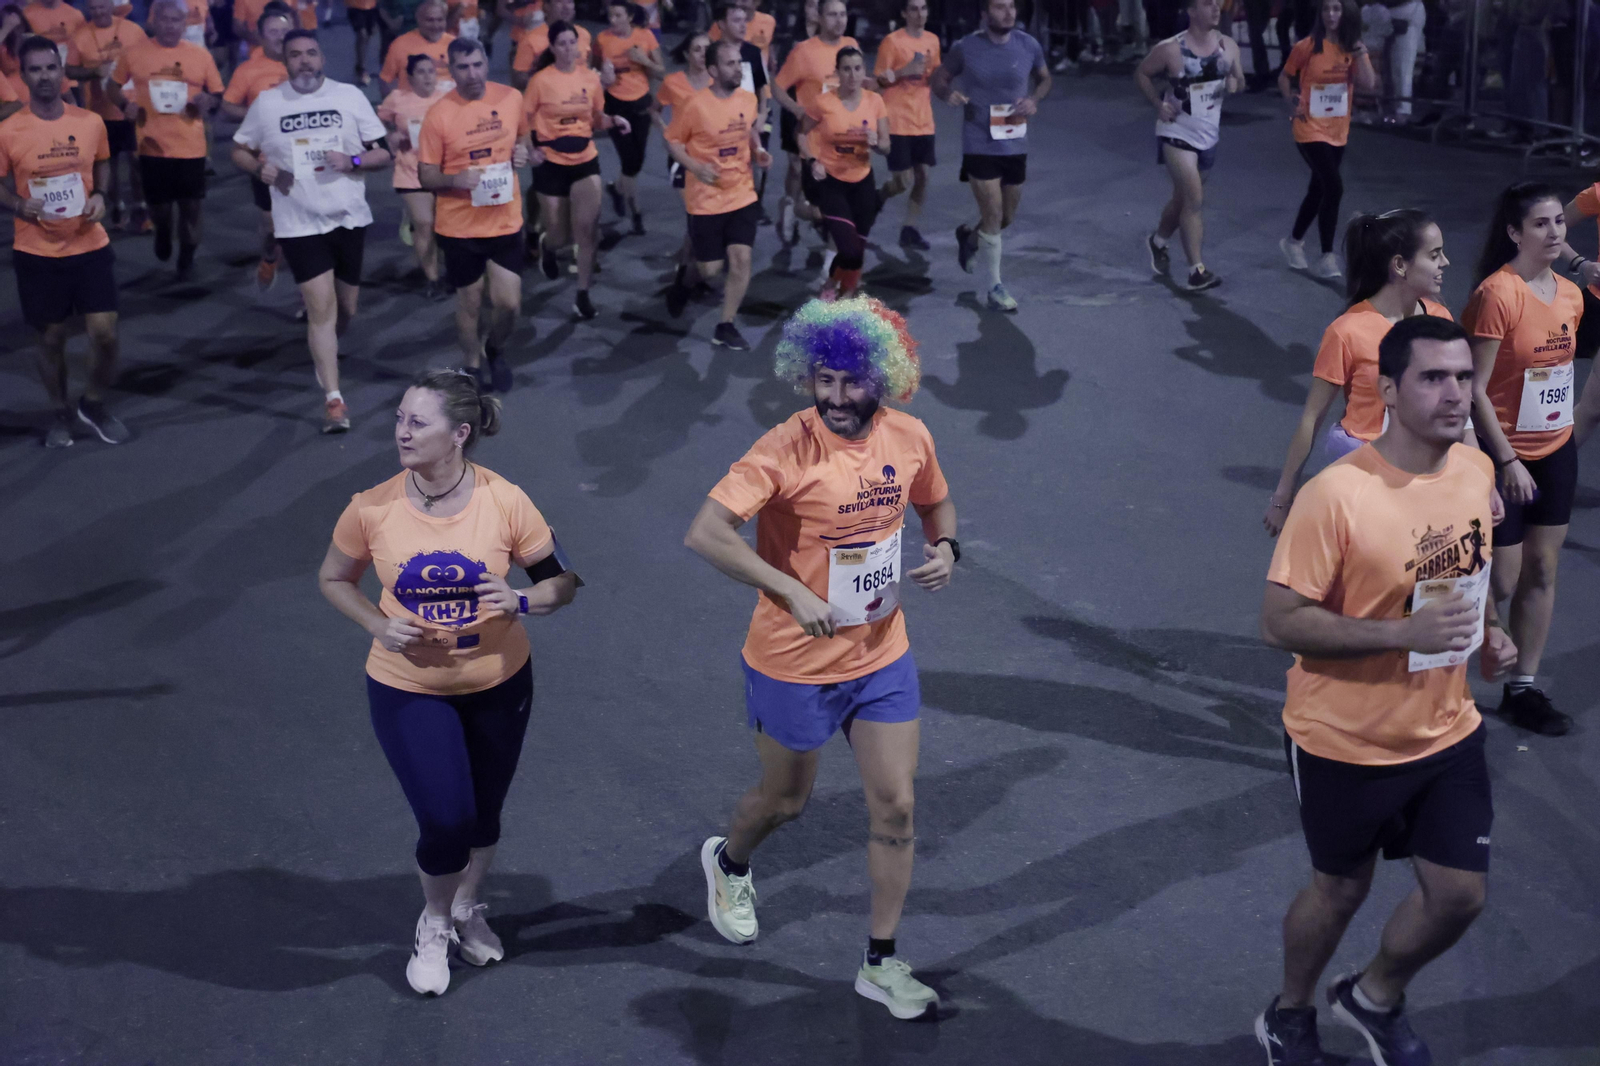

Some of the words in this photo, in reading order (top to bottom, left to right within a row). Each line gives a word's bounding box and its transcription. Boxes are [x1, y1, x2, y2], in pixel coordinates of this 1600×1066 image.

[282, 112, 342, 130] adidas
[43, 189, 74, 202] 10851
[1534, 344, 1558, 353] SEVILLA
[857, 484, 902, 500] NOCTURNA
[838, 499, 875, 514] SEVILLA
[1416, 544, 1460, 582] CARRERA
[853, 562, 893, 593] 16884
[422, 601, 466, 620] KH-7
